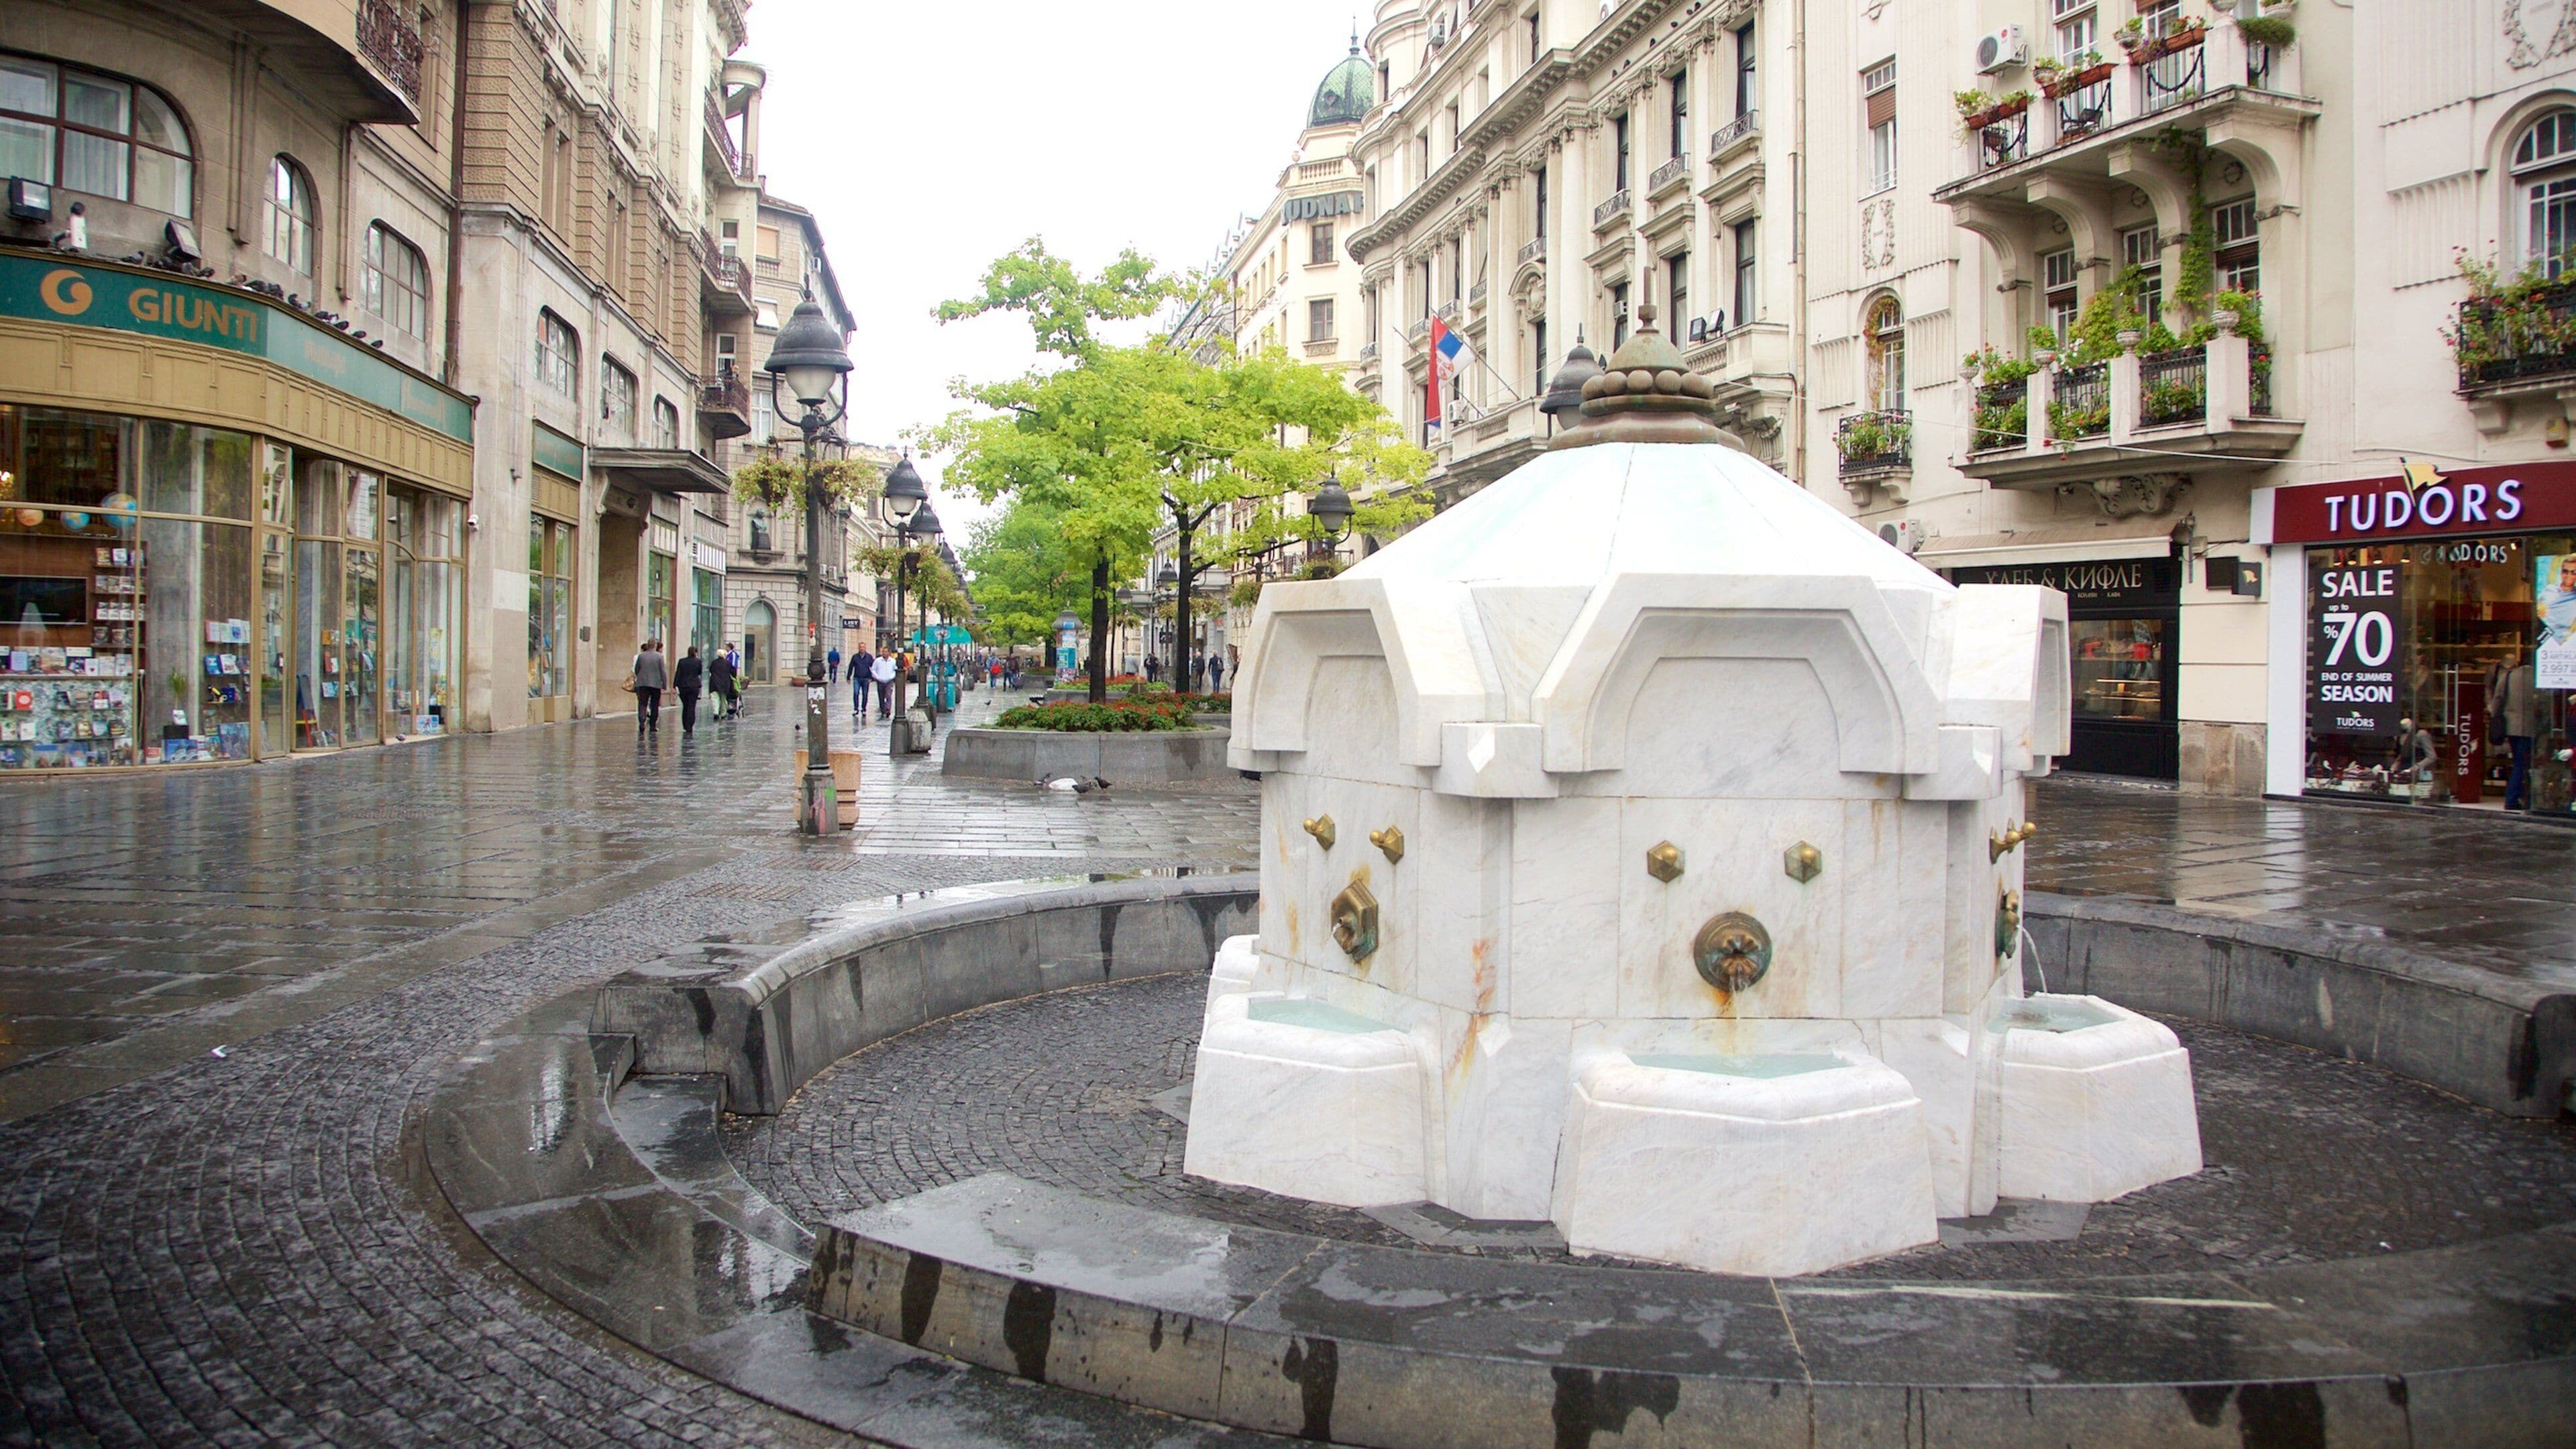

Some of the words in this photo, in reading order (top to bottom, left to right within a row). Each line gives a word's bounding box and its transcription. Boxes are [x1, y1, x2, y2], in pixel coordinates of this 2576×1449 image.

[129, 287, 258, 342] GIUNTI
[2324, 479, 2522, 532] TUDORS
[2041, 568, 2056, 590] &
[2064, 564, 2142, 590] КИФЛЕ
[2322, 569, 2394, 598] SALE
[2321, 672, 2339, 682] END
[2341, 672, 2354, 682] OF
[2355, 673, 2393, 682] SUMMER
[2321, 685, 2393, 702] SEASON
[2336, 717, 2374, 727] TUDORS
[2457, 714, 2471, 775] TUDORS
